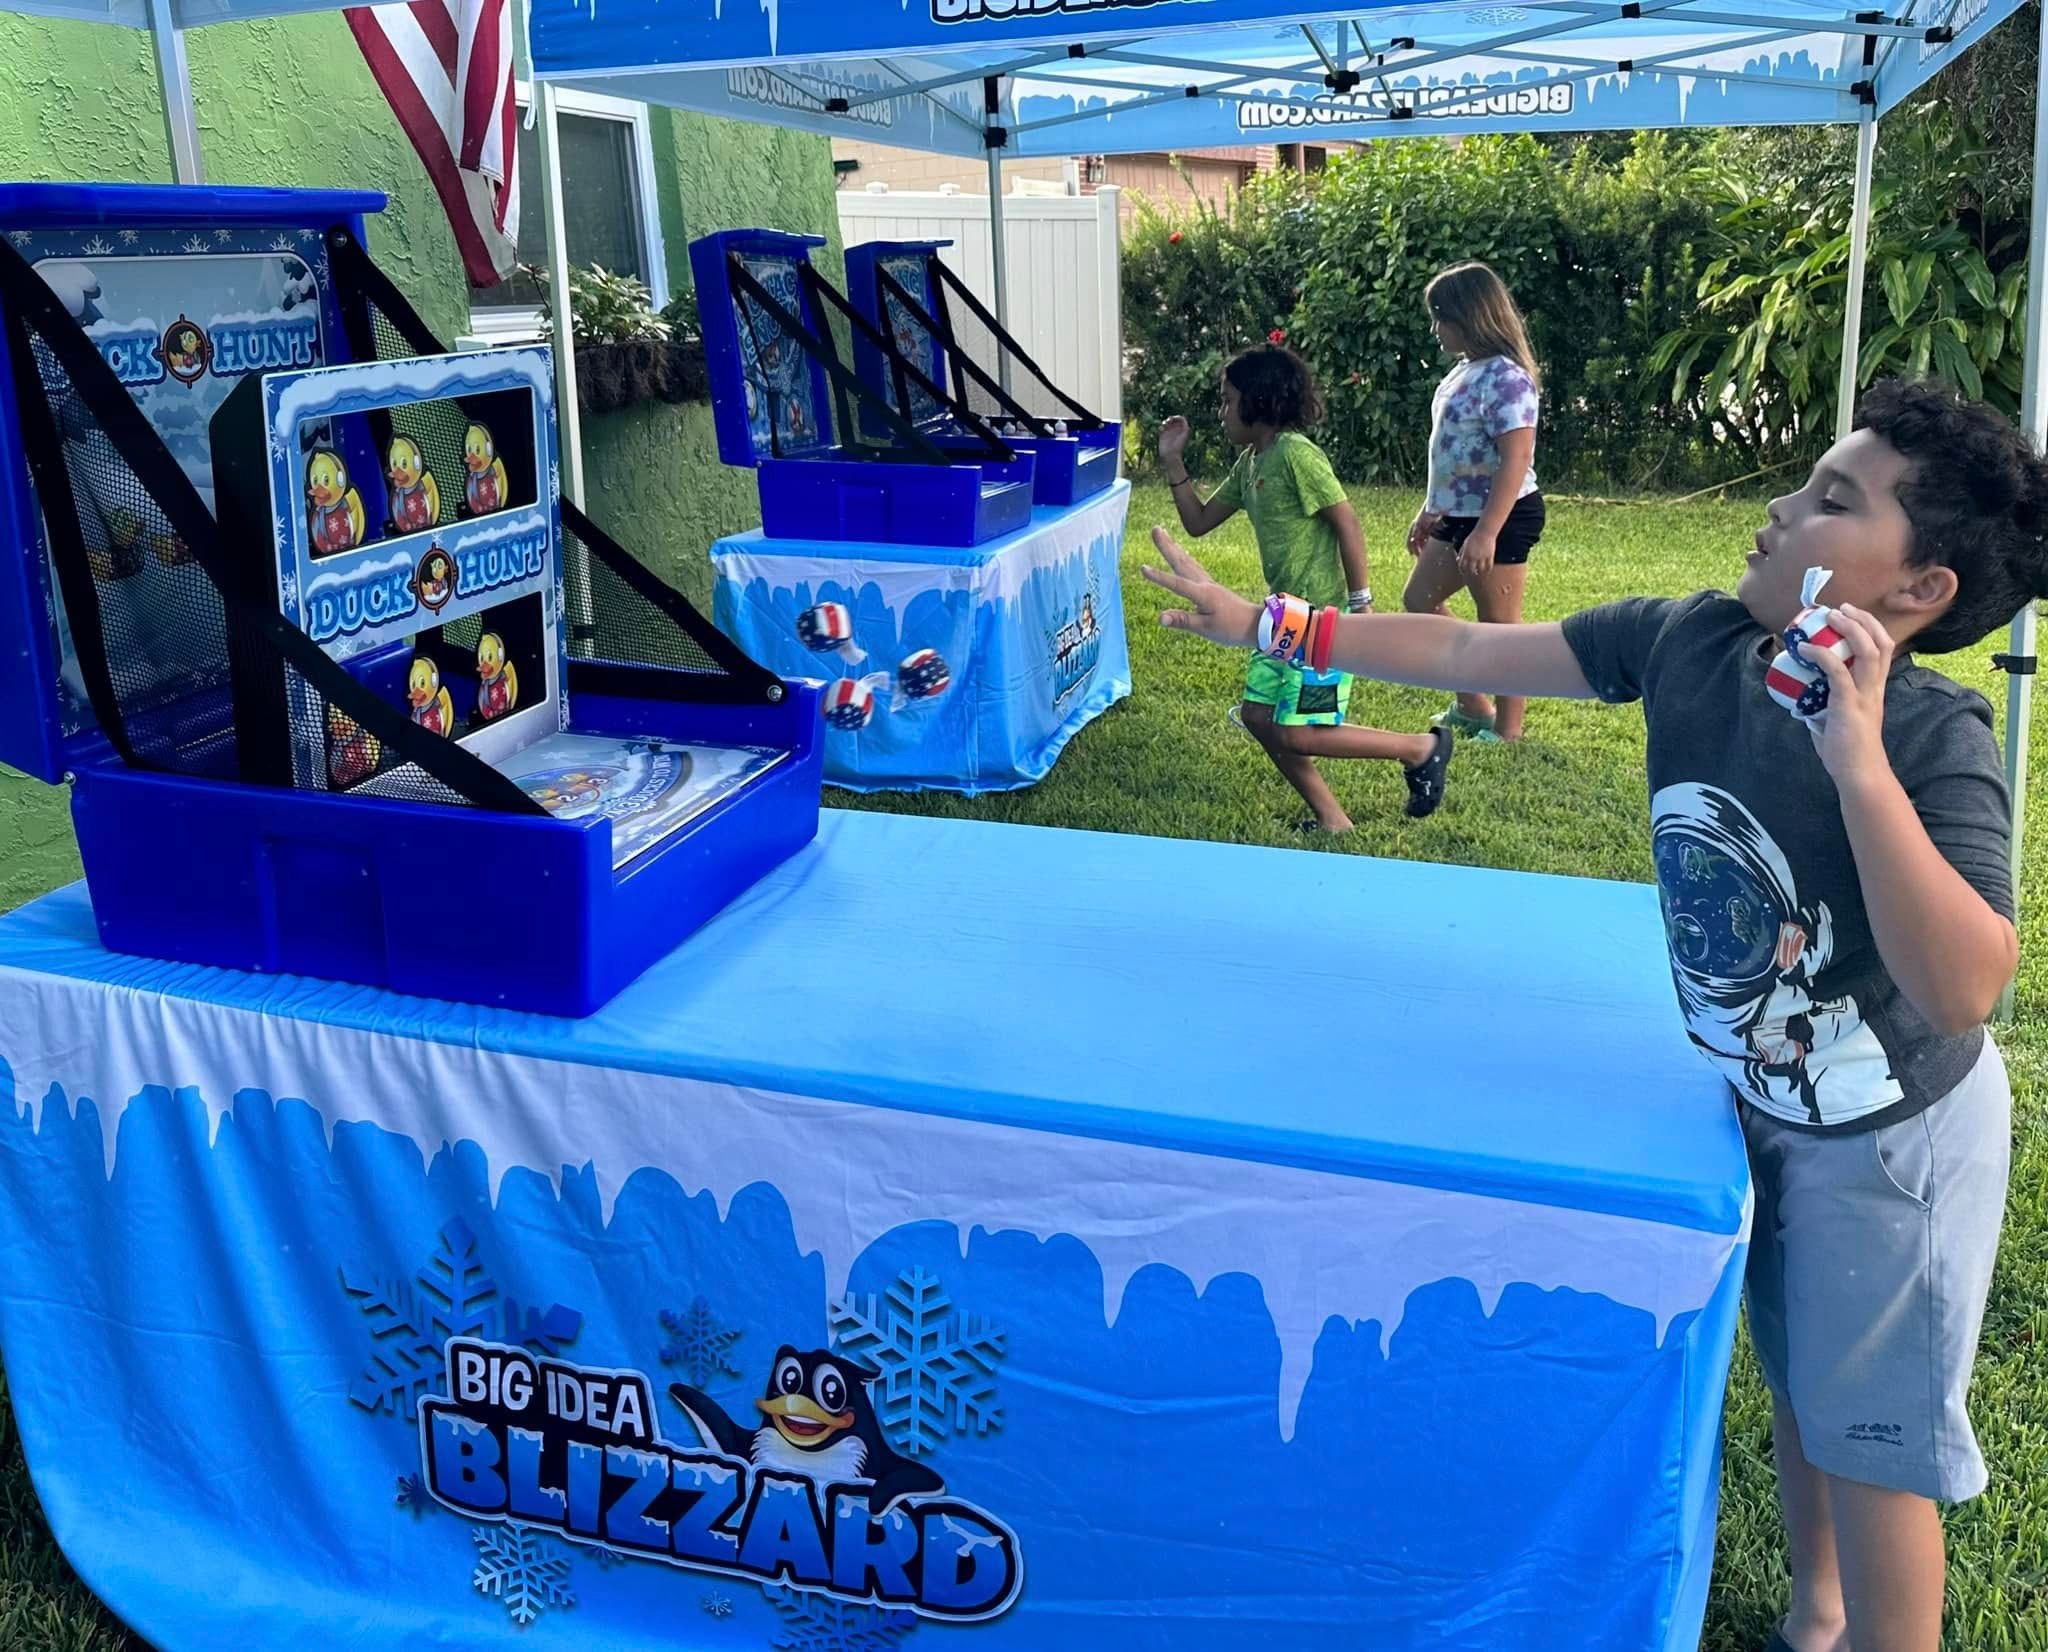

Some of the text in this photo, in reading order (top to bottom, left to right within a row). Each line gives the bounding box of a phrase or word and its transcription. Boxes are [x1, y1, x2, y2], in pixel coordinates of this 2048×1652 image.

[99, 325, 317, 384] CK HUNT
[308, 530, 549, 642] DUCK HUNT
[628, 778, 667, 801] DUCKS
[651, 766, 671, 778] TO
[457, 1350, 646, 1438] BIG IDEA
[430, 1408, 1004, 1608] BLIZZARD
